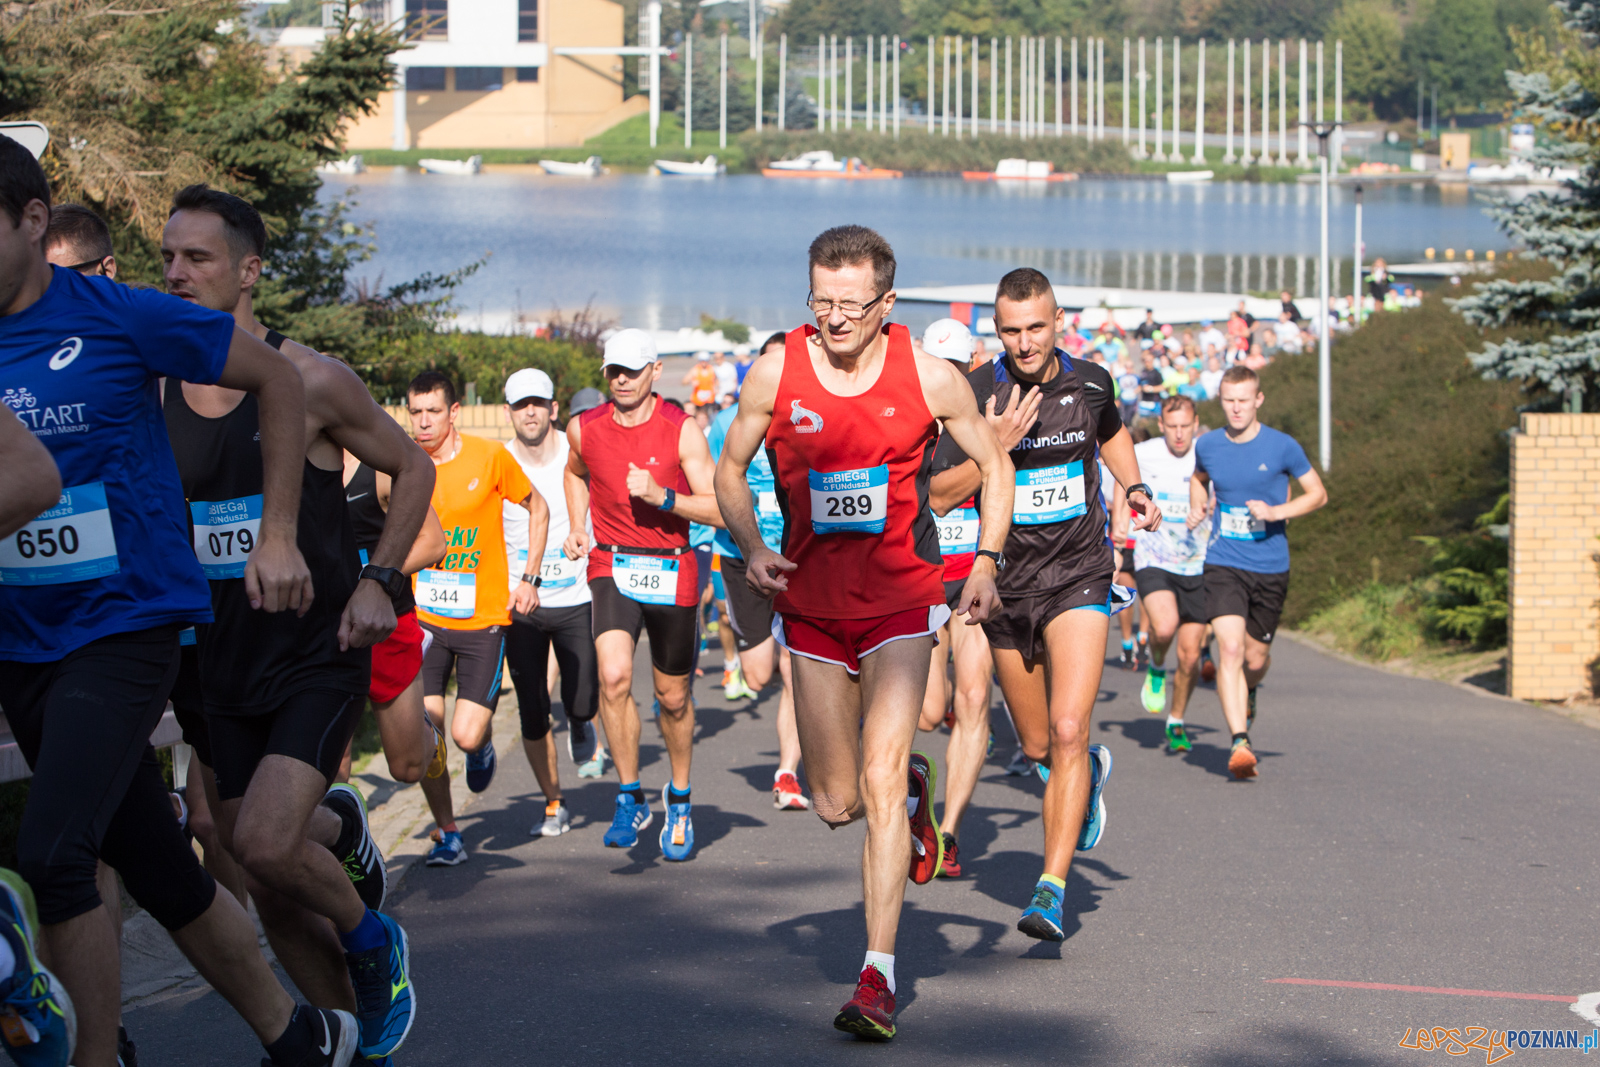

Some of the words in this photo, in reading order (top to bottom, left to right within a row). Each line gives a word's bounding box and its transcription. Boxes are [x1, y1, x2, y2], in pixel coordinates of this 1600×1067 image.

[16, 403, 86, 428] START
[57, 424, 90, 436] Mazury
[823, 470, 870, 484] zaBIEGaj
[1029, 465, 1068, 479] zaBIEGaj
[830, 480, 870, 491] FUNdusze
[1032, 485, 1069, 507] 574
[37, 506, 74, 519] dusze
[825, 494, 872, 517] 289
[16, 525, 79, 559] 650
[208, 528, 254, 557] 079
[540, 563, 562, 577] 75
[629, 574, 660, 589] 548
[430, 588, 458, 603] 344
